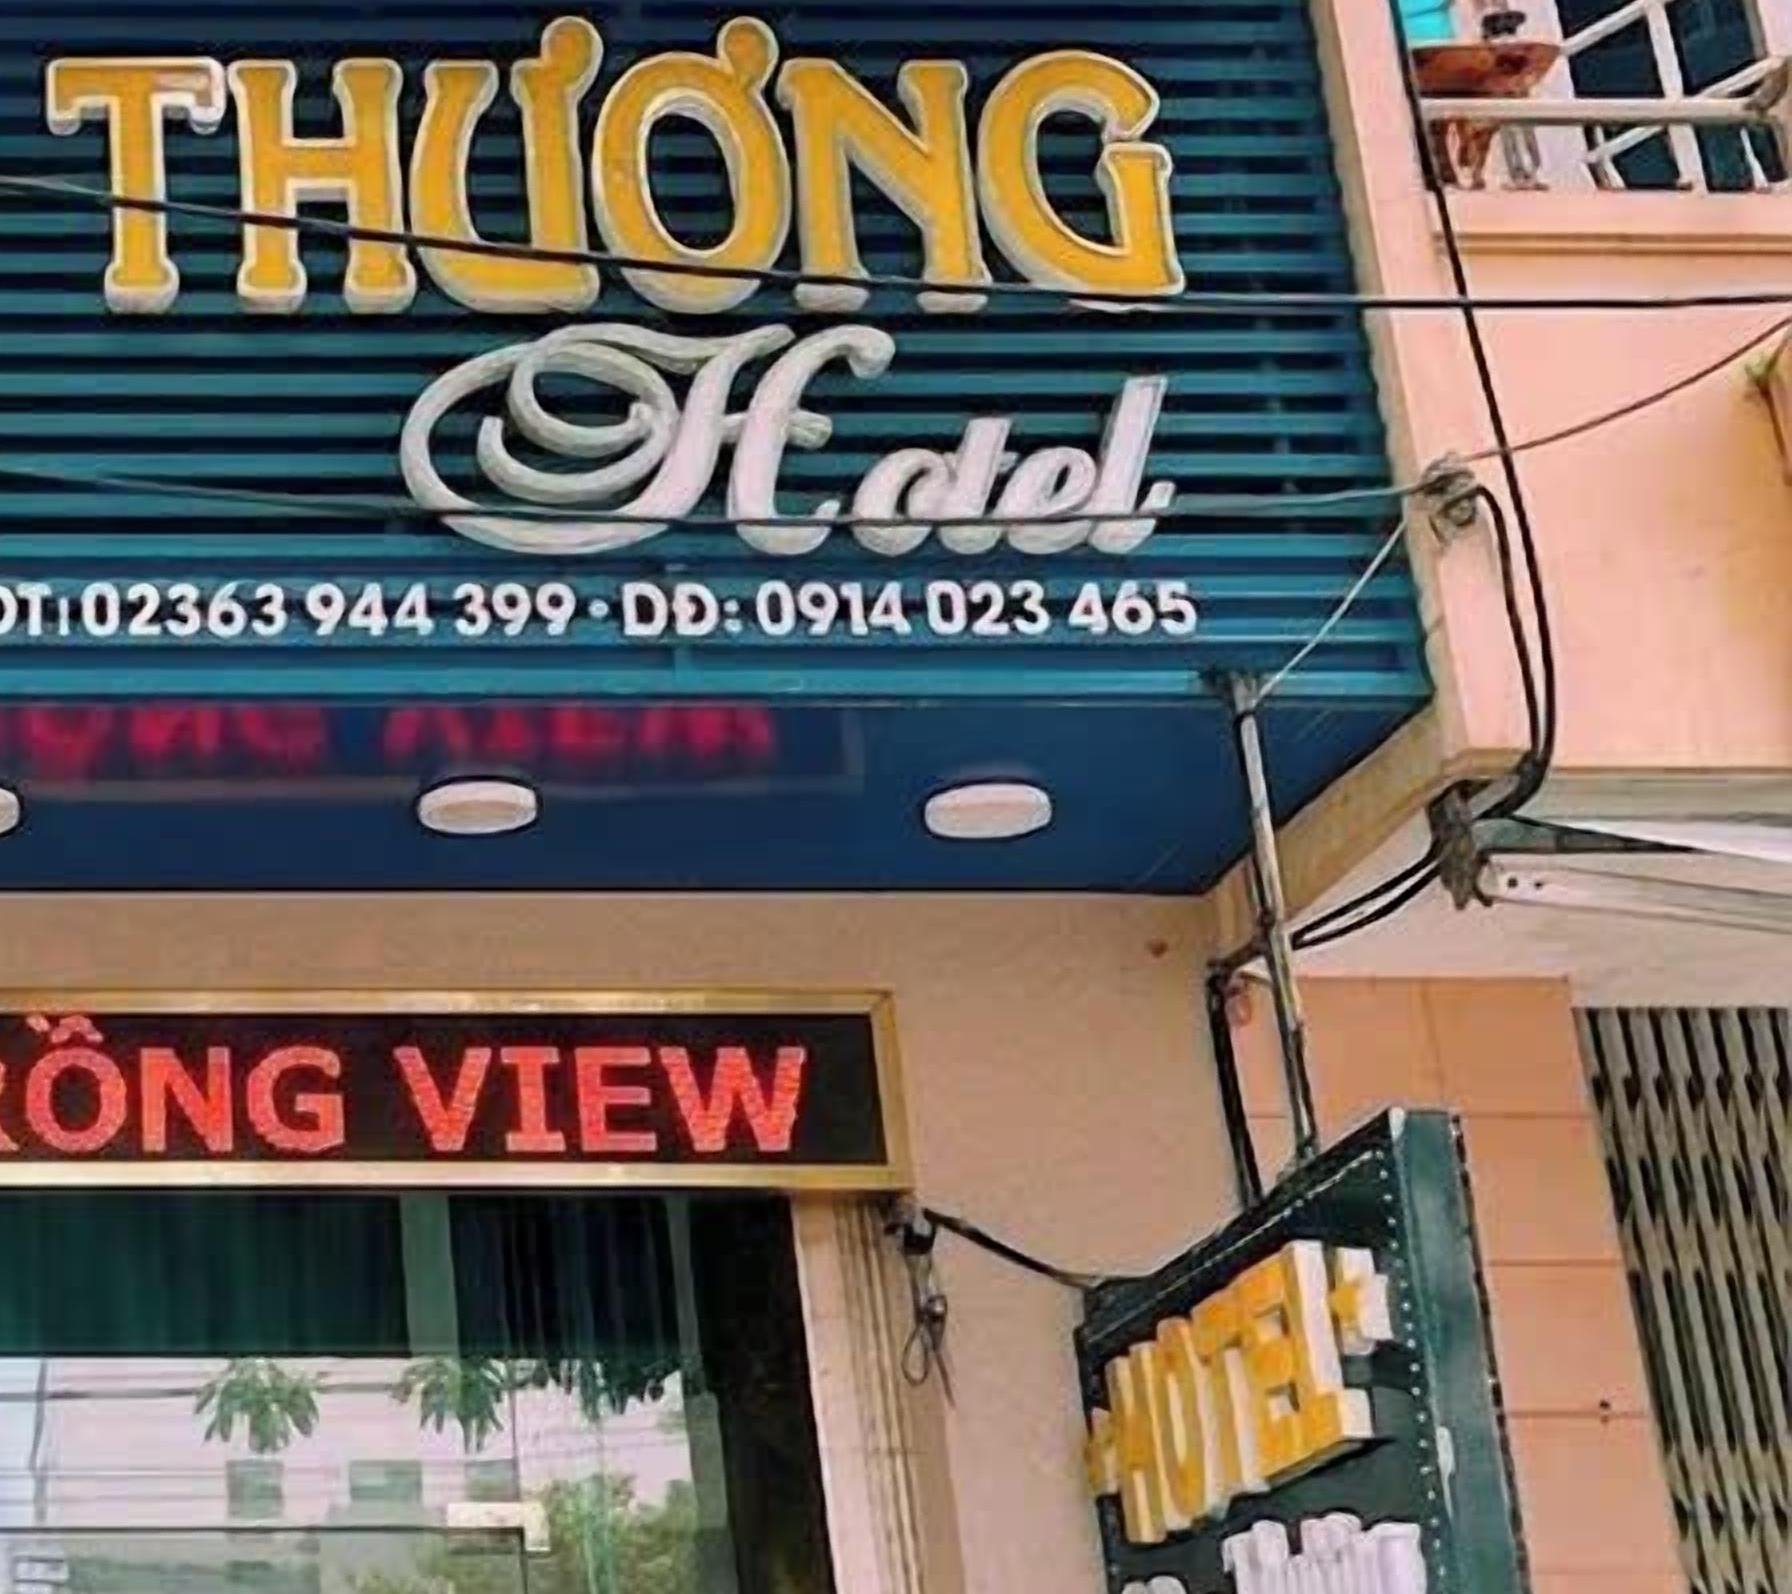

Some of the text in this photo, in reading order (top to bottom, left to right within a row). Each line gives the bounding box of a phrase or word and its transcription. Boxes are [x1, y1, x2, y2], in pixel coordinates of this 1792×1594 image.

[46, 15, 1186, 315] THƯƠNG
[400, 322, 1176, 555] Hotel
[306, 581, 434, 637] 944
[755, 580, 911, 637] 0914
[926, 580, 1052, 636] 023
[1067, 580, 1198, 636] 465
[394, 1045, 806, 1154] VIEW
[1106, 1239, 1376, 1544] HOTEL
